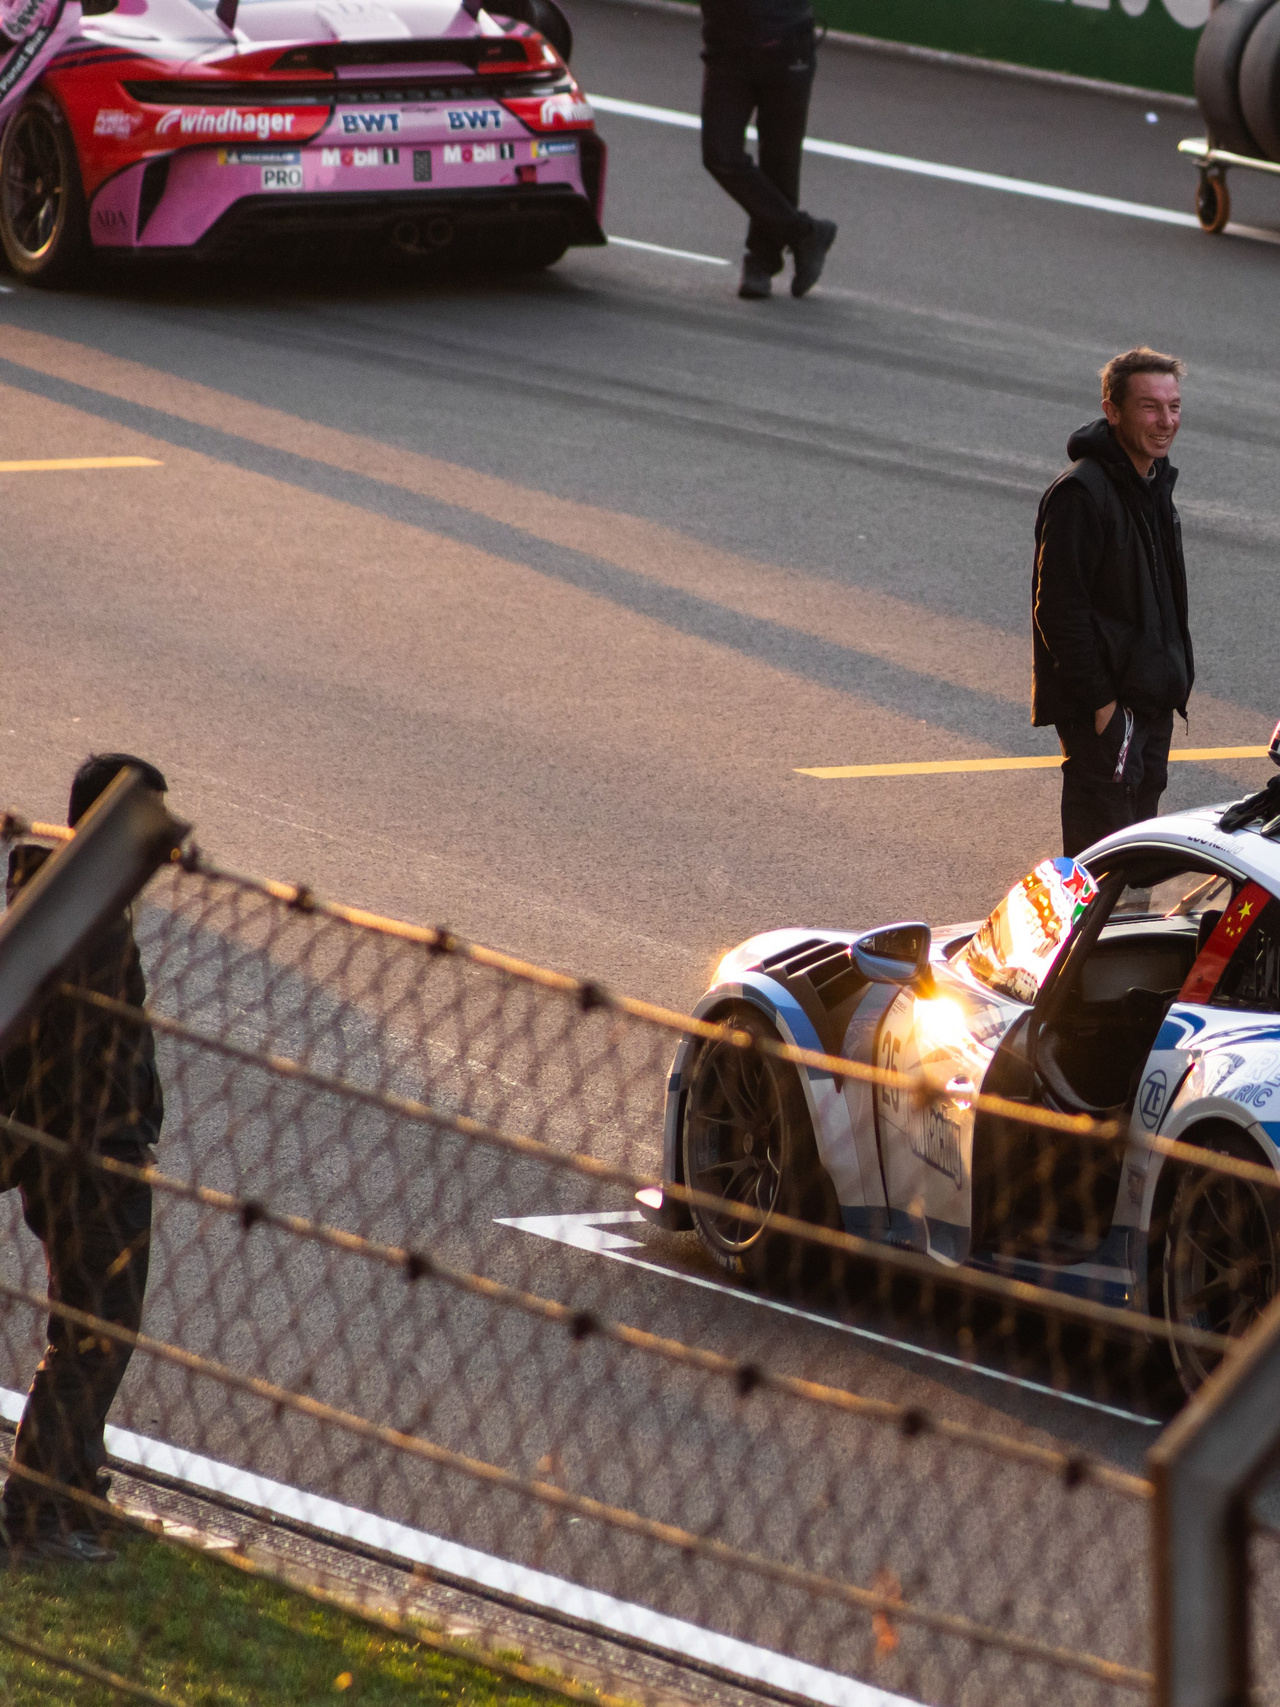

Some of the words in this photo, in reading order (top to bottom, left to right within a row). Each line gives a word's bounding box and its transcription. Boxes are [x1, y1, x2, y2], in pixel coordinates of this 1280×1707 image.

[180, 108, 295, 139] windhager
[342, 113, 399, 133] BWT
[447, 110, 501, 130] BWT
[322, 146, 379, 167] Mobil
[443, 143, 497, 164] Mobil
[264, 169, 301, 187] PRO
